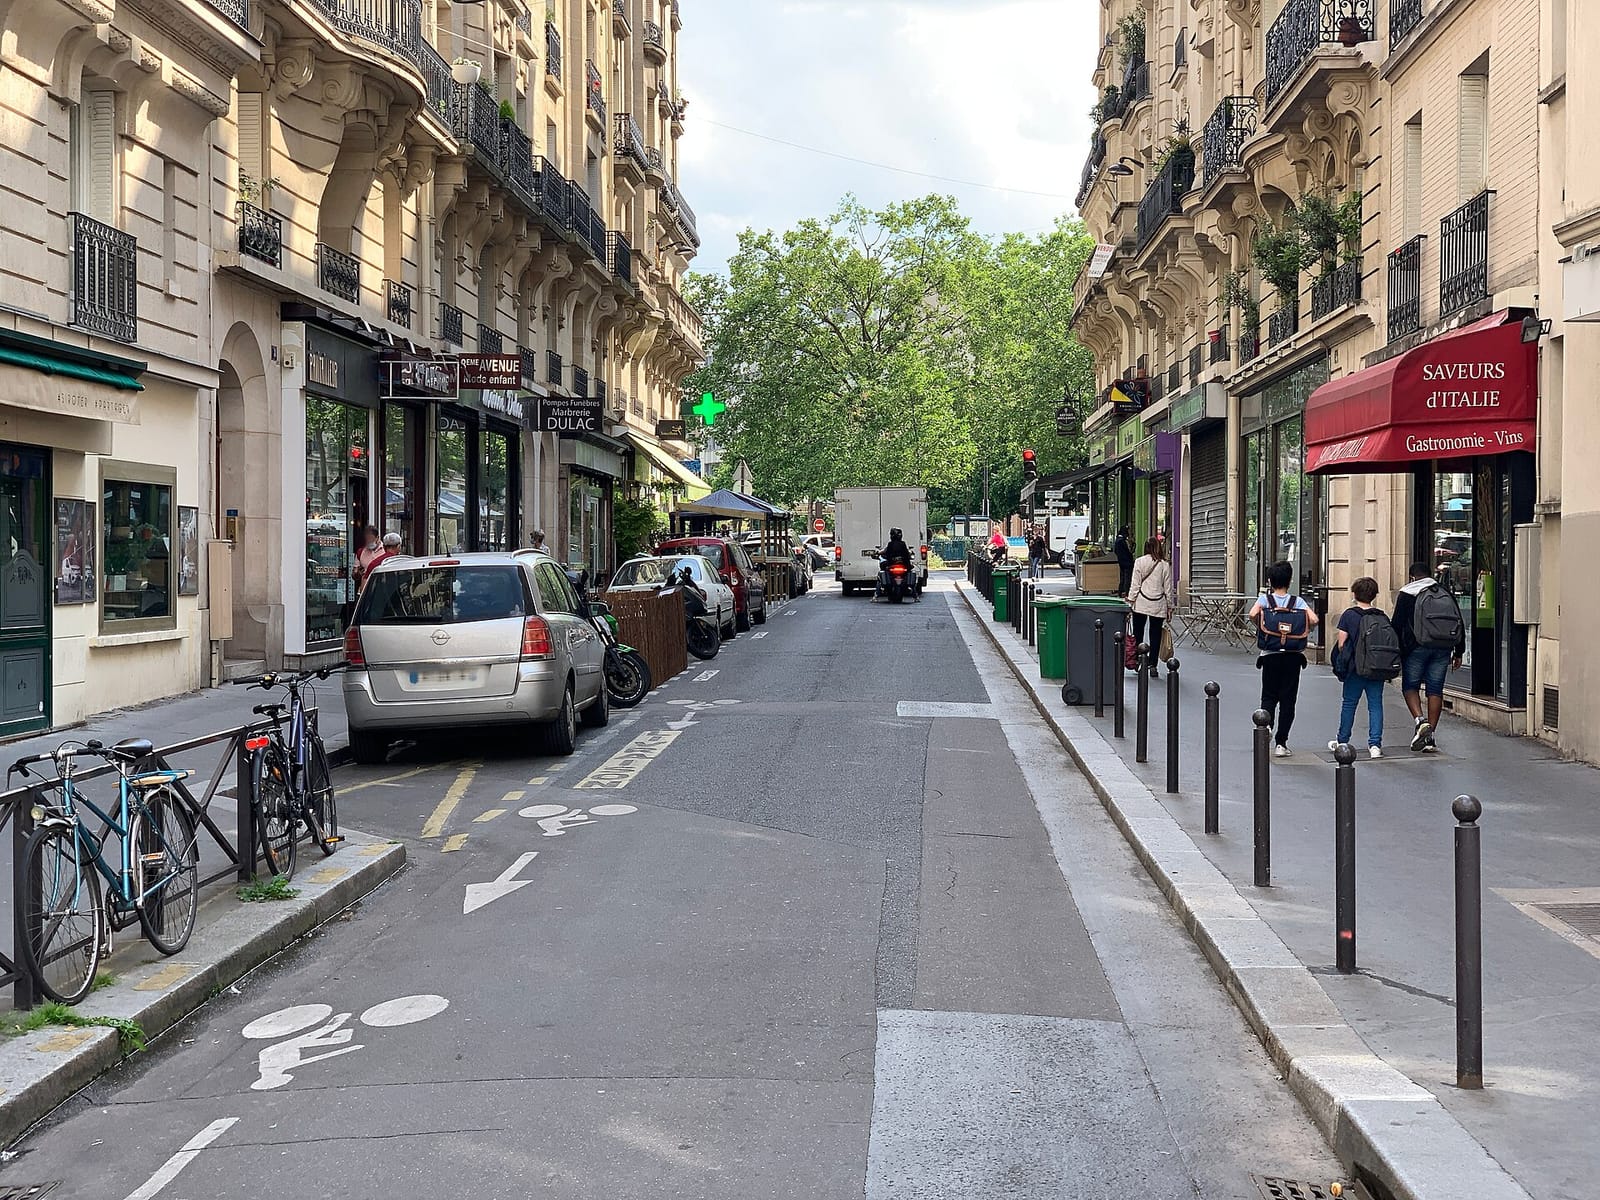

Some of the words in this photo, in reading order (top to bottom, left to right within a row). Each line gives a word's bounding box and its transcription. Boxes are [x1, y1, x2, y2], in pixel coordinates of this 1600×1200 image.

[479, 359, 521, 373] AVENUE
[1423, 362, 1505, 381] SAVEURS
[463, 374, 487, 385] Mode
[488, 374, 517, 386] enfant
[542, 399, 569, 407] Pompes
[570, 399, 600, 408] Funèbres
[1426, 390, 1500, 409] d'ITALIE
[551, 407, 591, 417] Marbrerie
[547, 416, 595, 431] DULAC
[1406, 432, 1485, 453] Gastronomie
[1494, 430, 1524, 446] Vins
